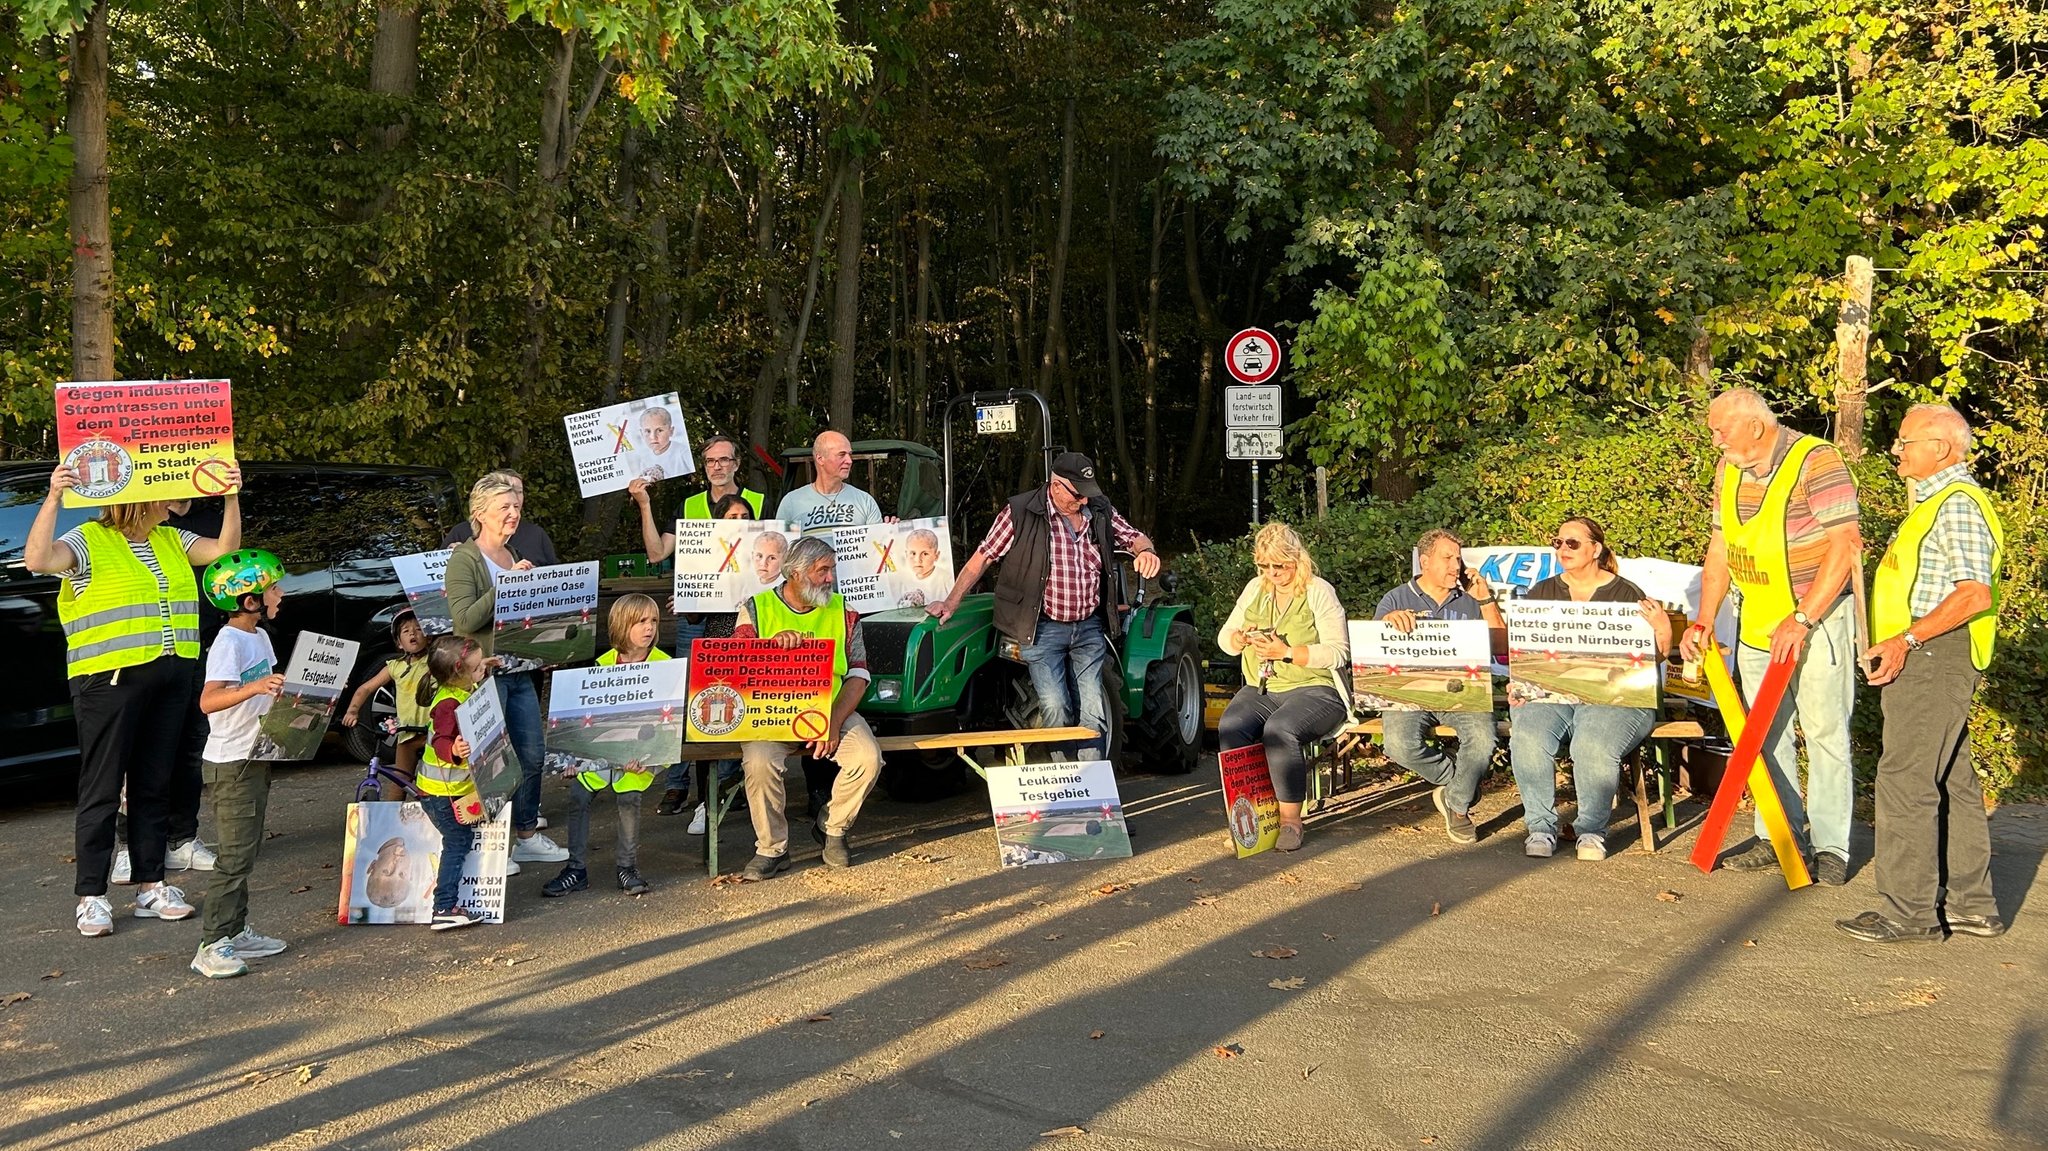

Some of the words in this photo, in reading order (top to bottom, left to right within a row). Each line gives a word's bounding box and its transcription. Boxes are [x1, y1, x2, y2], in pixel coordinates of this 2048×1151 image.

[68, 387, 123, 400] Gegen
[129, 383, 220, 398] industrielle
[1235, 392, 1256, 401] Land-
[1258, 392, 1271, 400] und
[64, 400, 179, 416] Stromtrassen
[184, 398, 226, 409] unter
[567, 411, 602, 424] TENNET
[987, 409, 993, 419] N
[1233, 413, 1259, 422] Verkehr
[1262, 413, 1274, 422] frei
[76, 418, 113, 430] dem
[119, 412, 216, 428] Deckmantel
[569, 420, 600, 432] MACHT
[979, 420, 992, 432] SG
[995, 420, 1012, 431] 161
[123, 425, 231, 443] „Erneuerbare
[571, 429, 594, 439] MICH
[139, 438, 218, 454] Energien“
[573, 434, 604, 447] KRANK
[134, 458, 153, 471] im
[157, 455, 201, 469] Stadt-
[578, 455, 618, 470] SCHÜTZT
[579, 463, 615, 477] UNSERE
[143, 470, 190, 485] gebiet
[581, 472, 614, 485] KINDER
[679, 521, 717, 529] TENNET
[804, 512, 854, 527] JONES
[679, 530, 712, 538] MACHT
[834, 527, 869, 538] TENNET
[835, 536, 866, 546] MACHT
[678, 547, 712, 555] KRANK
[836, 545, 859, 554] MICH
[837, 552, 868, 562] KRANK
[498, 572, 534, 584] Tennet
[537, 569, 574, 580] verbaut
[575, 566, 590, 576] die
[1479, 552, 1565, 587] KEI
[677, 572, 721, 581] SCHÜTZT
[839, 575, 880, 587] SCHÜTZT
[497, 588, 527, 599] letzte
[530, 584, 558, 598] grüne
[561, 581, 585, 592] Oase
[840, 583, 876, 595] UNSERE
[496, 604, 510, 615] im
[512, 600, 544, 612] Süden
[547, 593, 596, 608] Nürnbergs
[1617, 607, 1638, 617] die
[1509, 618, 1548, 629] letzte
[1552, 619, 1592, 632] grüne
[1597, 620, 1633, 632] Oase
[1380, 632, 1451, 642] Leukämie
[1510, 632, 1526, 642] im
[1530, 632, 1573, 644] Süden
[1577, 634, 1652, 649] Nürnbergs
[701, 640, 746, 651] Gegen
[307, 648, 341, 666] Leukämie
[697, 652, 790, 663] Stromtrassen
[793, 654, 830, 663] unter
[1380, 646, 1458, 658] Testgebiet
[587, 667, 603, 675] Wir
[606, 664, 627, 674] sind
[629, 663, 650, 671] kein
[704, 666, 734, 676] dem
[738, 666, 820, 676] Deckmantel
[301, 668, 337, 685] Testgebiet
[581, 674, 650, 690] Leukämie
[740, 677, 831, 689] „Erneuerbare
[578, 689, 654, 706] Testgebiet
[752, 690, 819, 702] Energien“
[746, 705, 761, 714] im
[765, 705, 802, 715] Stadt-
[752, 717, 791, 727] gebiet
[1224, 752, 1246, 763] Gegen
[1020, 765, 1036, 773] Wir
[1039, 764, 1057, 772] sind
[1059, 763, 1079, 771] kein
[1018, 773, 1082, 787] Leukämie
[1230, 780, 1246, 789] dem
[1019, 788, 1091, 802] Testgebiet
[462, 876, 503, 886] KRANK
[472, 887, 502, 897] MICH
[460, 899, 501, 908] MACHT
